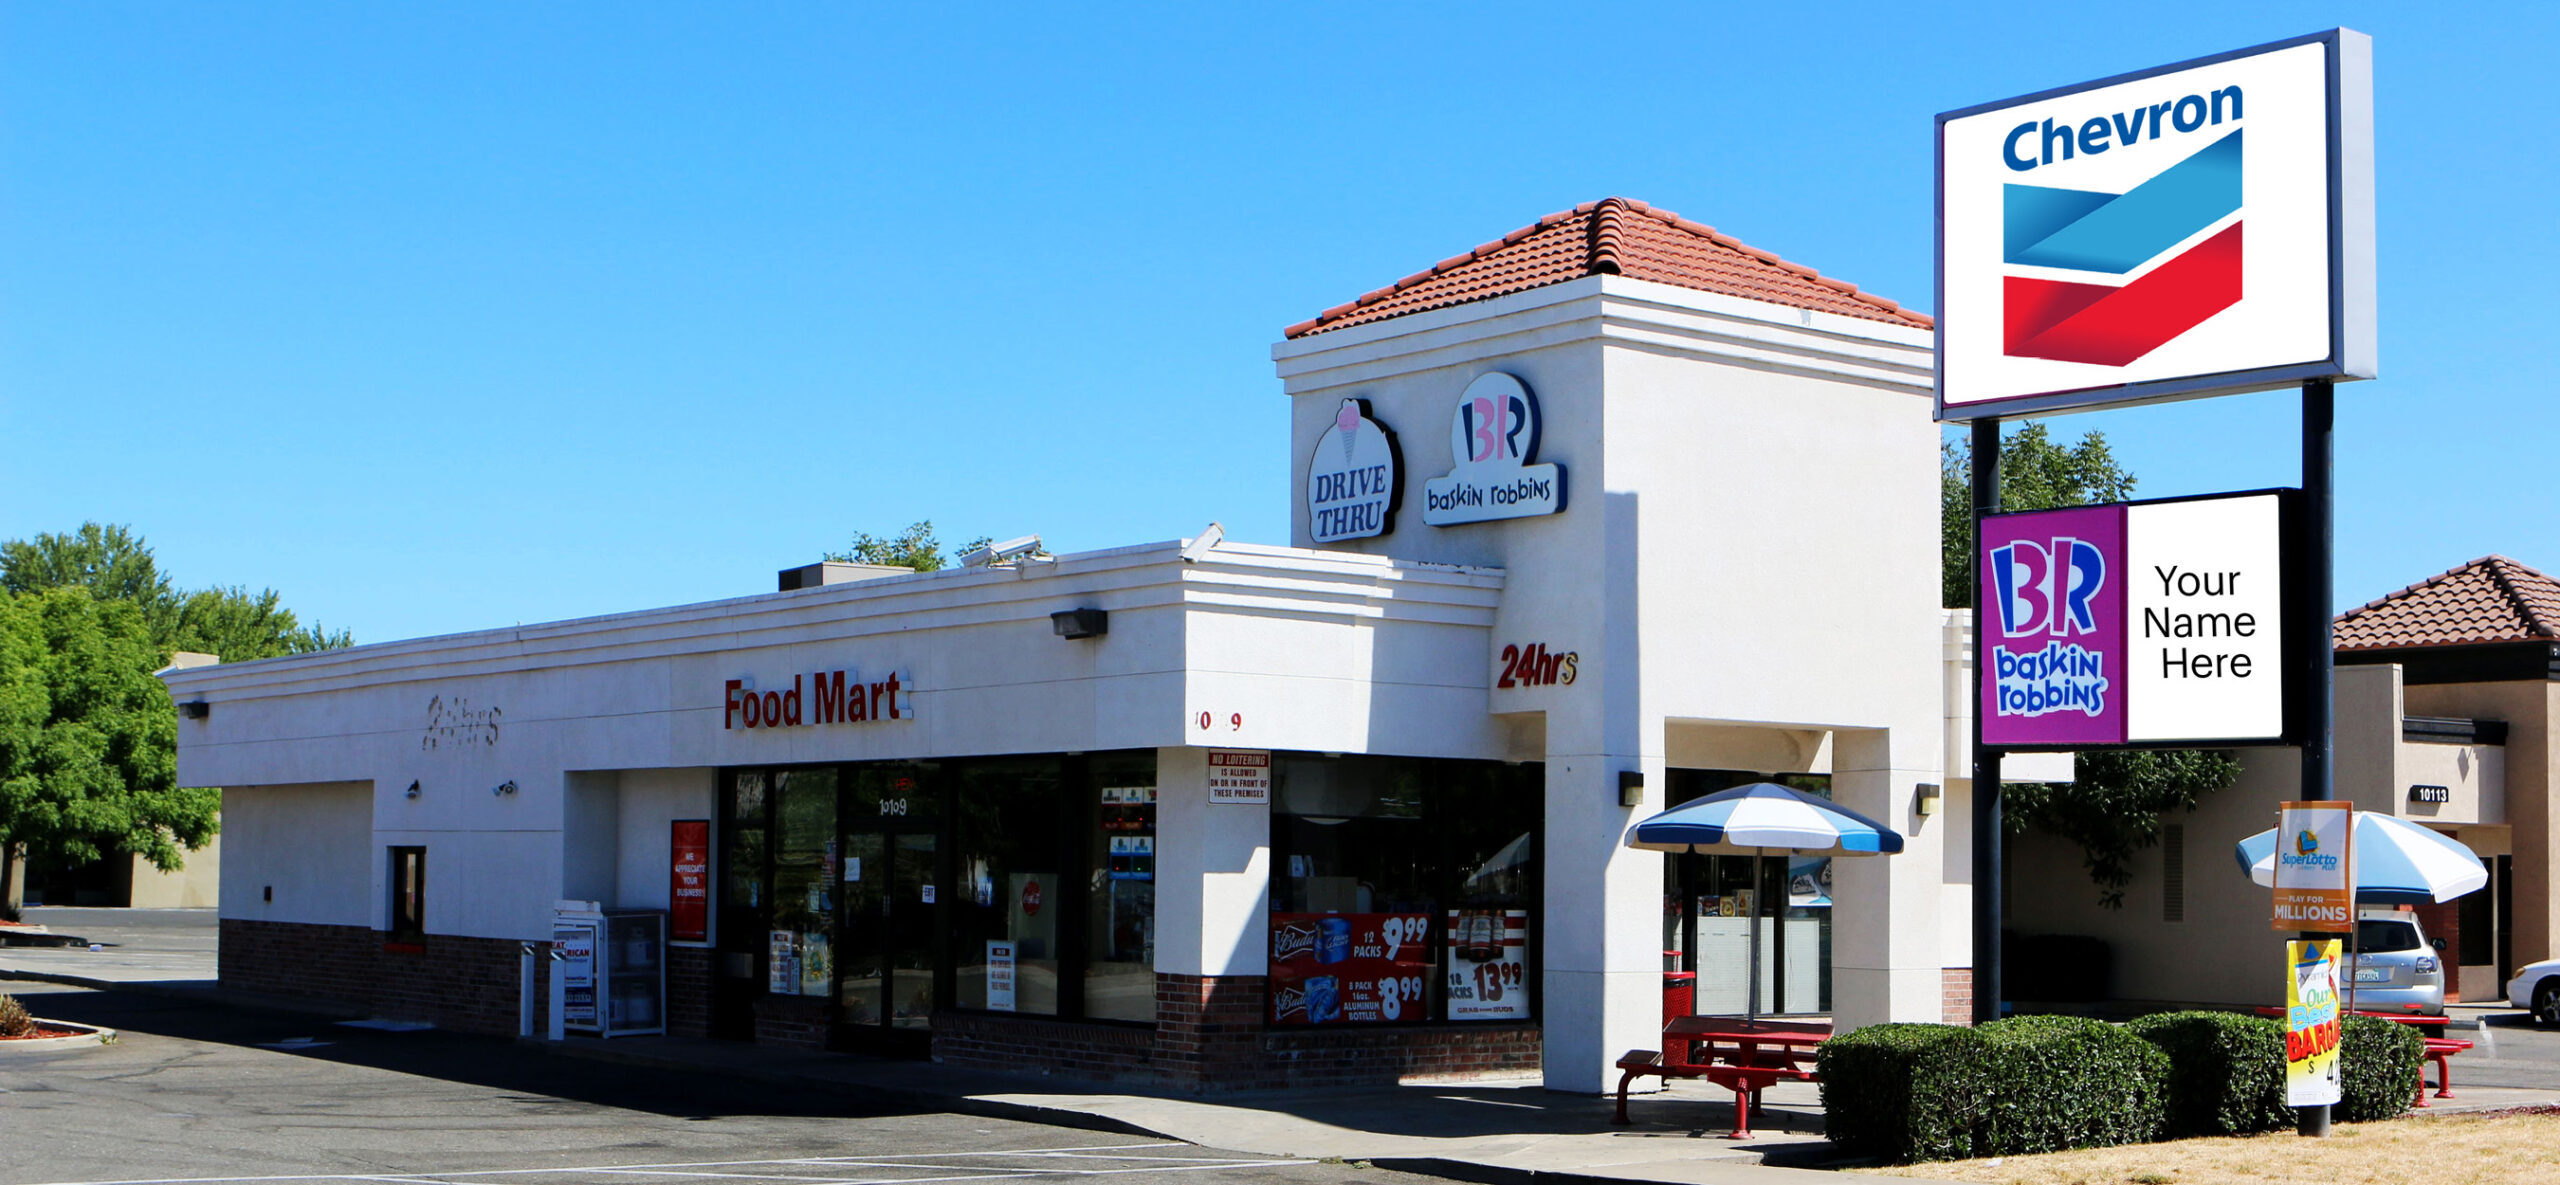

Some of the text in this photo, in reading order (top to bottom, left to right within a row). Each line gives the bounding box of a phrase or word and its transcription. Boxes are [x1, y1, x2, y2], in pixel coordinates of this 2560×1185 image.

[2003, 85, 2243, 172] Chevron
[1462, 394, 1526, 463] BR
[1315, 465, 1386, 503] DRIVE
[1428, 476, 1550, 511] baskin robbins
[1318, 501, 1382, 537] THRU
[1991, 538, 2105, 637] BR
[2155, 565, 2241, 596] Your
[2144, 607, 2256, 638] Name
[1497, 642, 1579, 688] 24hrs
[1996, 643, 2099, 681] baskin
[2162, 647, 2252, 678] Here
[725, 670, 900, 729] Food Mart
[1999, 678, 2101, 713] robbins
[1212, 754, 1265, 765] NO LOITERING
[1221, 768, 1256, 777] IS ALLOWED
[1211, 779, 1267, 788] ON OR IN FRONT OF
[1214, 789, 1264, 798] THESE PREMISES
[2420, 788, 2447, 802] 10113
[879, 798, 907, 816] 10109
[2282, 852, 2337, 868] SuperLotto
[2288, 895, 2324, 903] PLAY FOR
[2275, 904, 2347, 921] MILLIONS
[1364, 931, 1374, 943] 12
[567, 949, 590, 957] RICAN
[1354, 945, 1382, 958] PACKS
[1355, 981, 1372, 990] PACK
[1450, 973, 1462, 986] 18
[1448, 986, 1474, 999] ACKS
[2306, 988, 2331, 1007] Our
[1344, 1001, 1380, 1011] ALUMINUM
[1349, 1011, 1377, 1020] BOTTLES
[2290, 1001, 2336, 1032] Best
